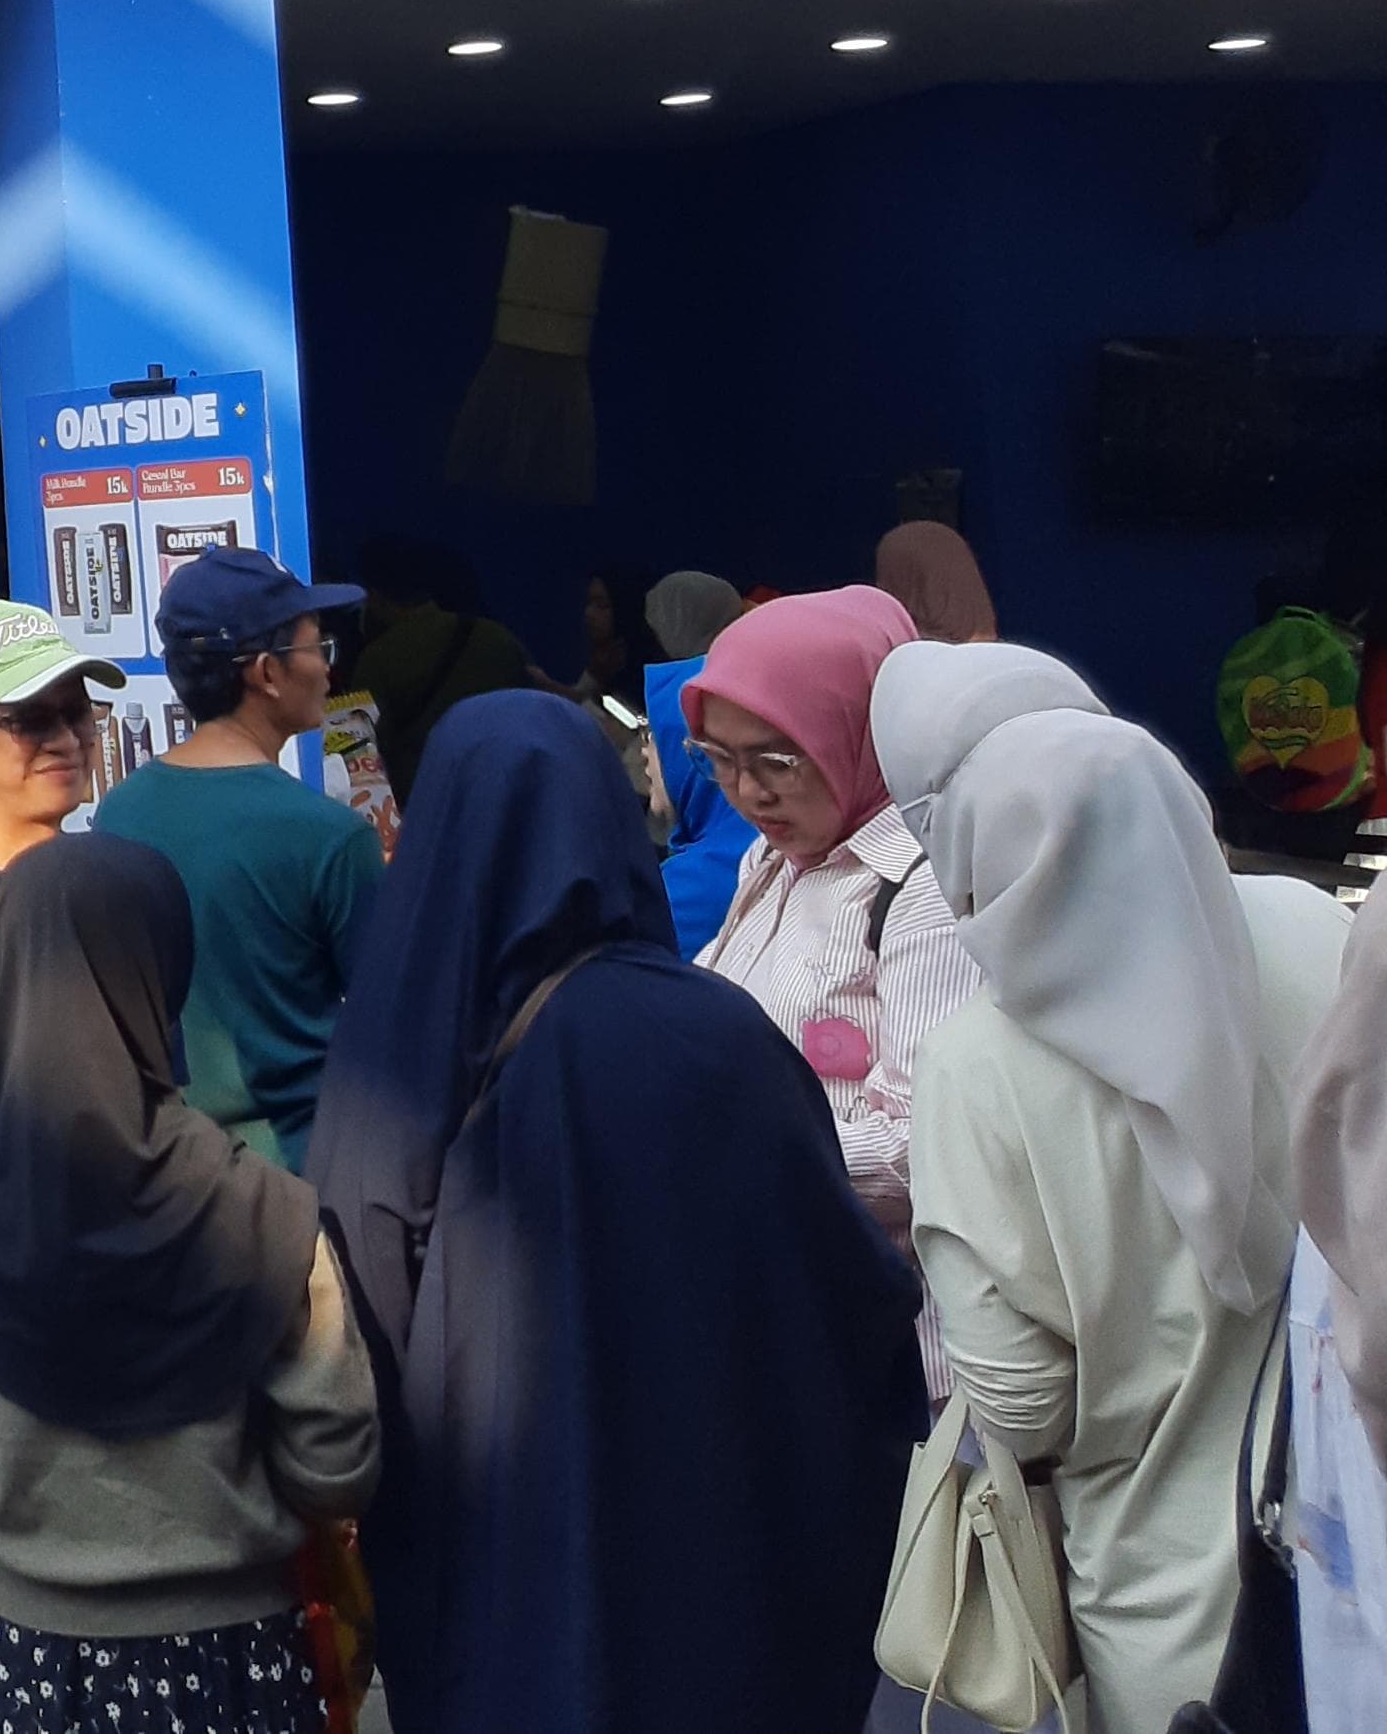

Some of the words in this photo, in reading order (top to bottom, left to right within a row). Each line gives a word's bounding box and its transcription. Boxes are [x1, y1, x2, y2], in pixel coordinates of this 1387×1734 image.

[56, 393, 220, 450] OATSIDE
[107, 476, 128, 495] 15k
[218, 466, 245, 487] 15k
